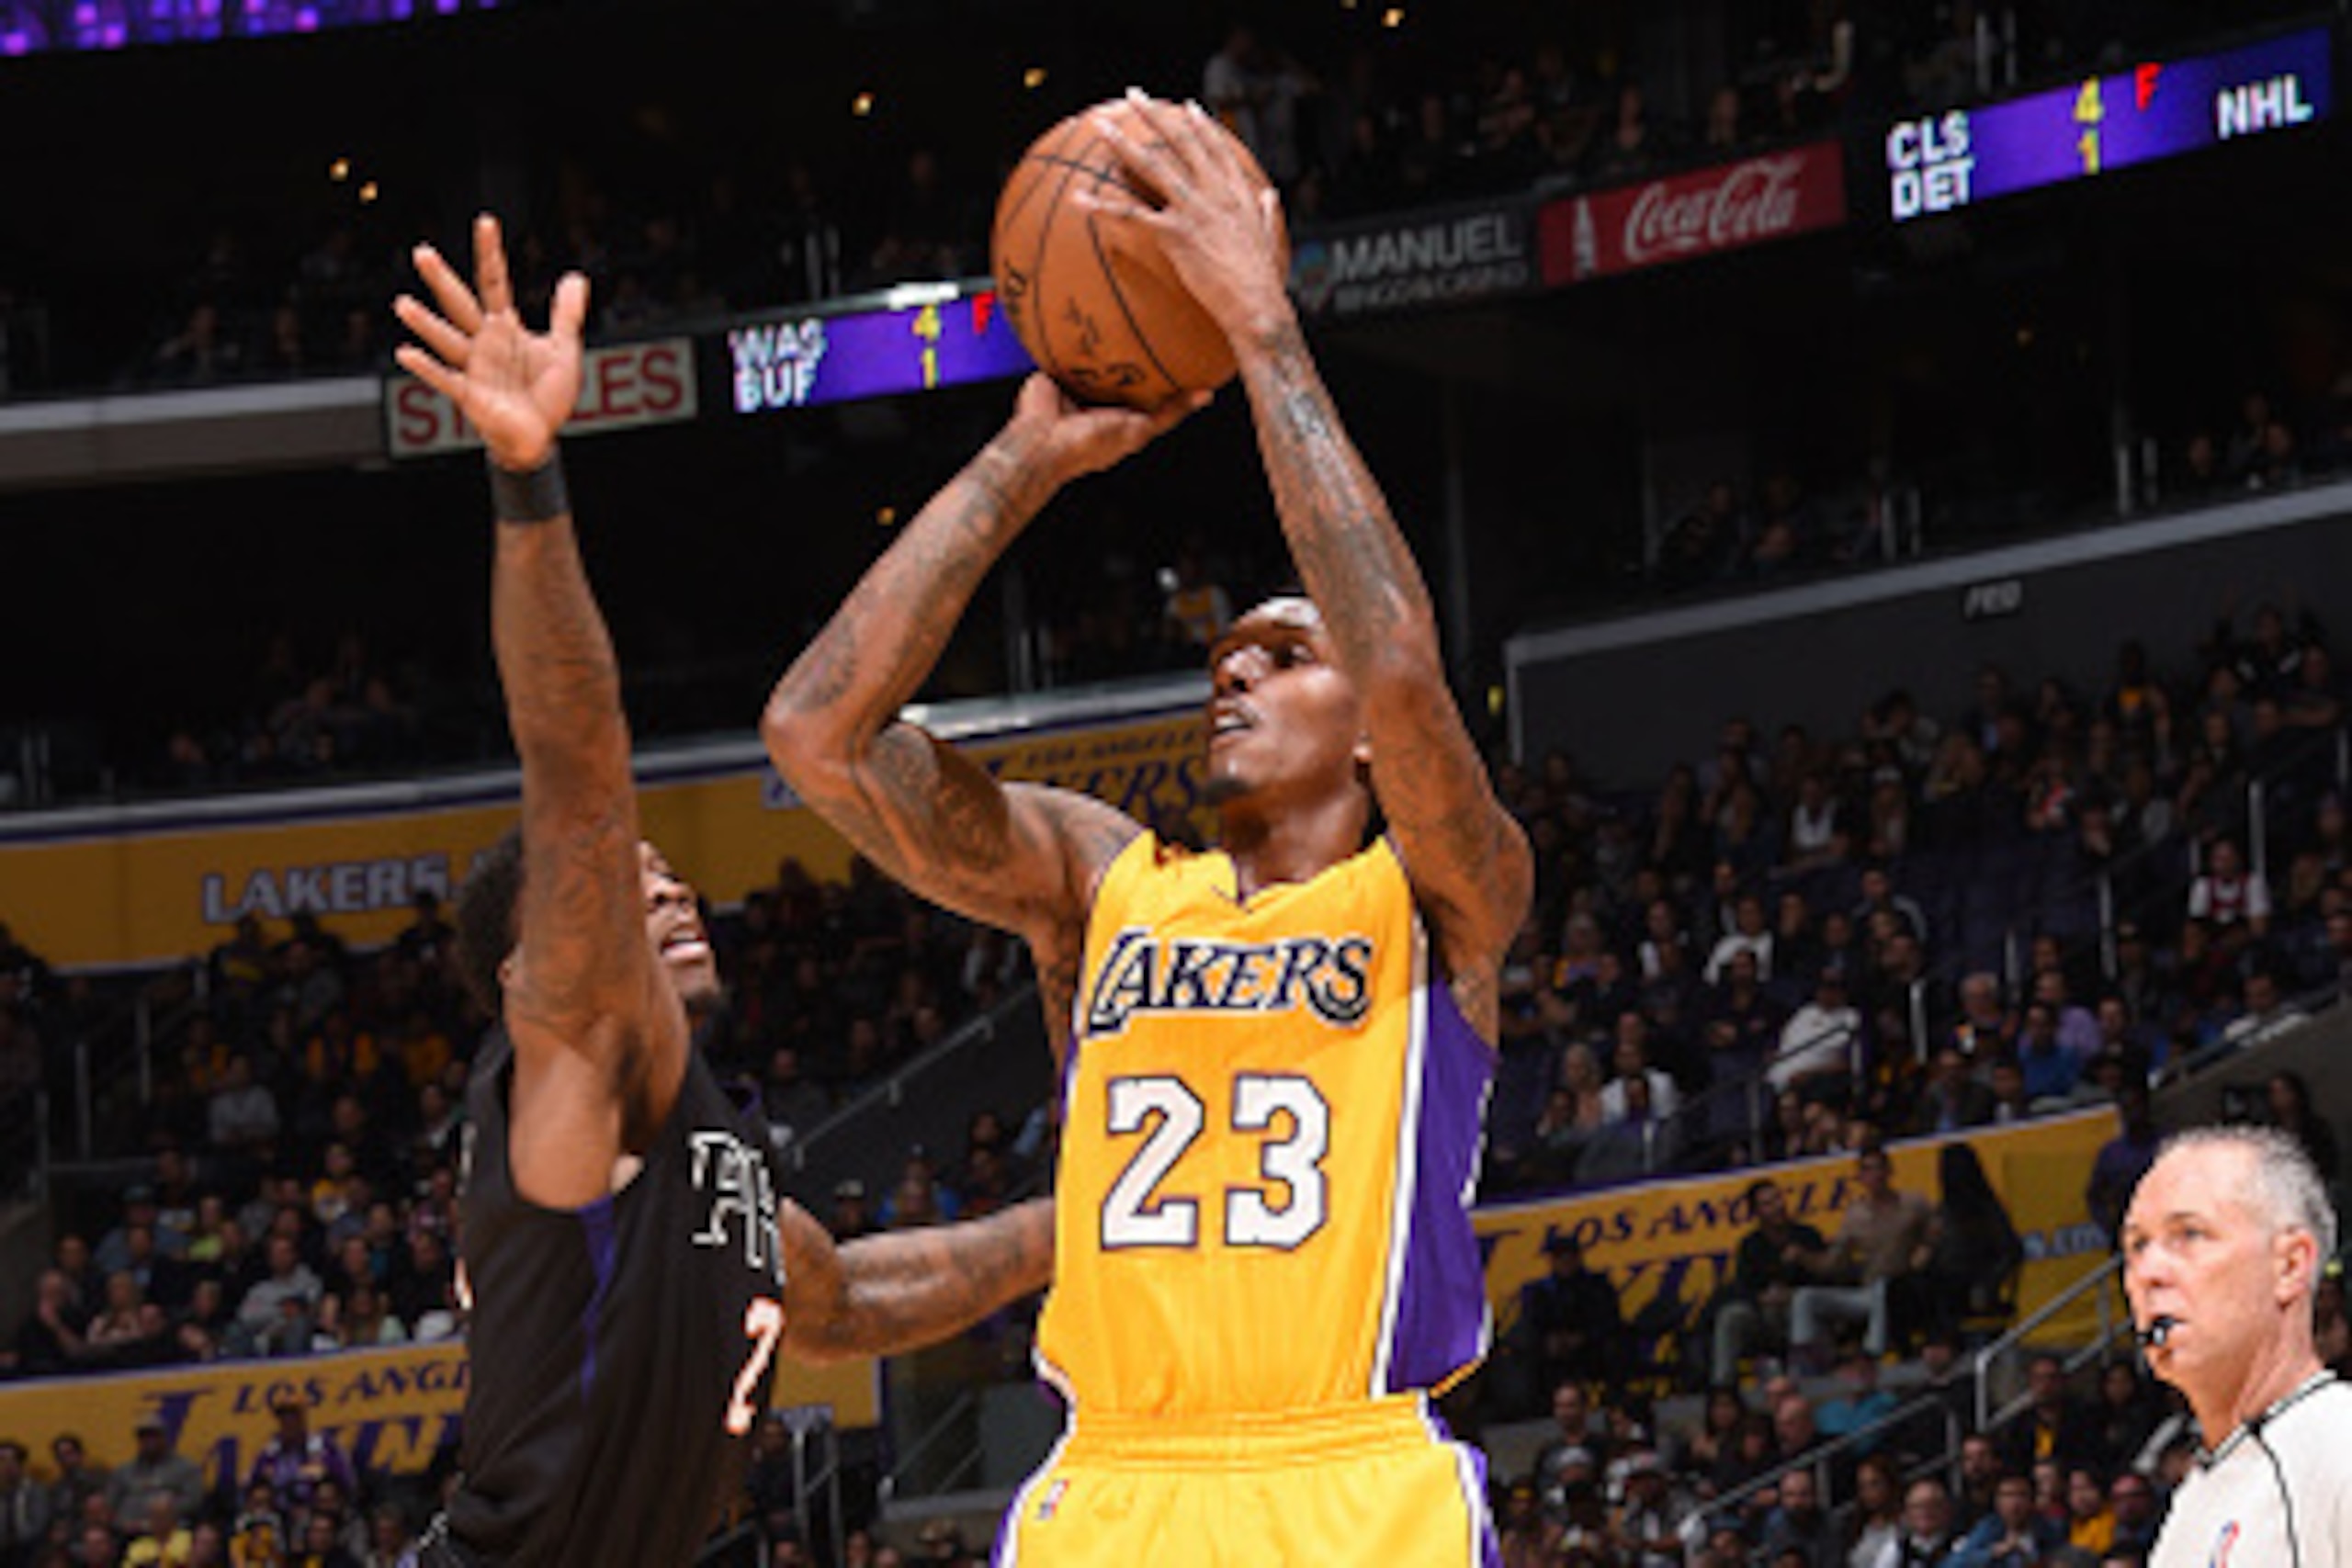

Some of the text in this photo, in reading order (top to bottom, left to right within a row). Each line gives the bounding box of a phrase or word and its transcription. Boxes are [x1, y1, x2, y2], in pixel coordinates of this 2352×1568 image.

[1887, 62, 2312, 168] CLS 4 F NHL
[1890, 129, 2099, 221] DET 1
[1332, 211, 1521, 280] MANUEL
[729, 291, 996, 368] WAS 4 F
[734, 348, 937, 412] BUF 1
[1086, 931, 1374, 1036] LAKERS
[1099, 1071, 1330, 1252] 23
[1541, 1207, 1639, 1255] LOS
[232, 1377, 329, 1415] LOS
